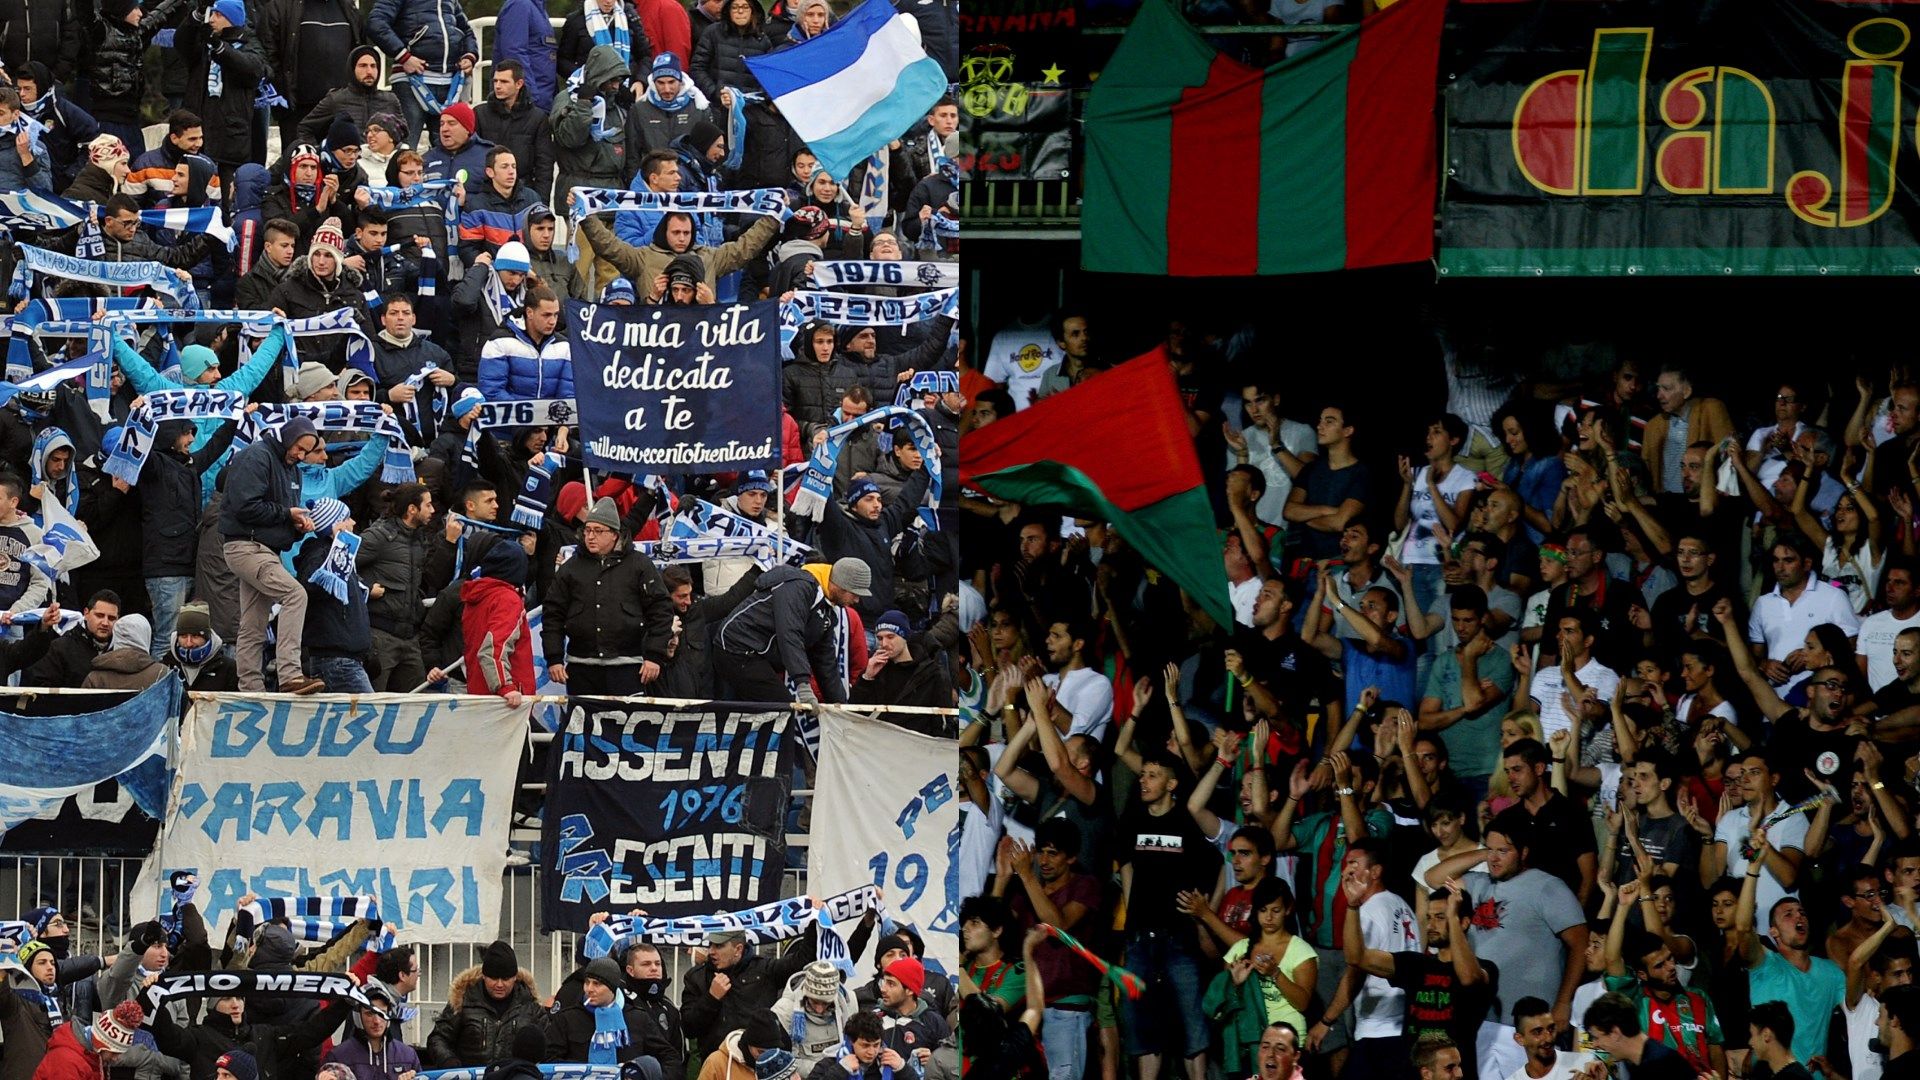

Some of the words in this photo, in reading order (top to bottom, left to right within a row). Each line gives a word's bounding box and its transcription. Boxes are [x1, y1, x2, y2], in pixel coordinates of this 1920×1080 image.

[1511, 17, 1914, 228] daj
[827, 262, 903, 284] 1976
[579, 304, 616, 345] La
[622, 311, 685, 348] mia
[695, 304, 766, 347] vita
[603, 350, 733, 390] dedicata
[481, 401, 534, 427] 976
[625, 407, 647, 431] a
[661, 395, 694, 431] te
[559, 705, 792, 782] ASSENTI
[174, 778, 486, 844] PARAVIA
[659, 782, 747, 832] 1976
[896, 773, 959, 840] PE
[868, 850, 930, 912] 19
[256, 974, 374, 1008] MERD
